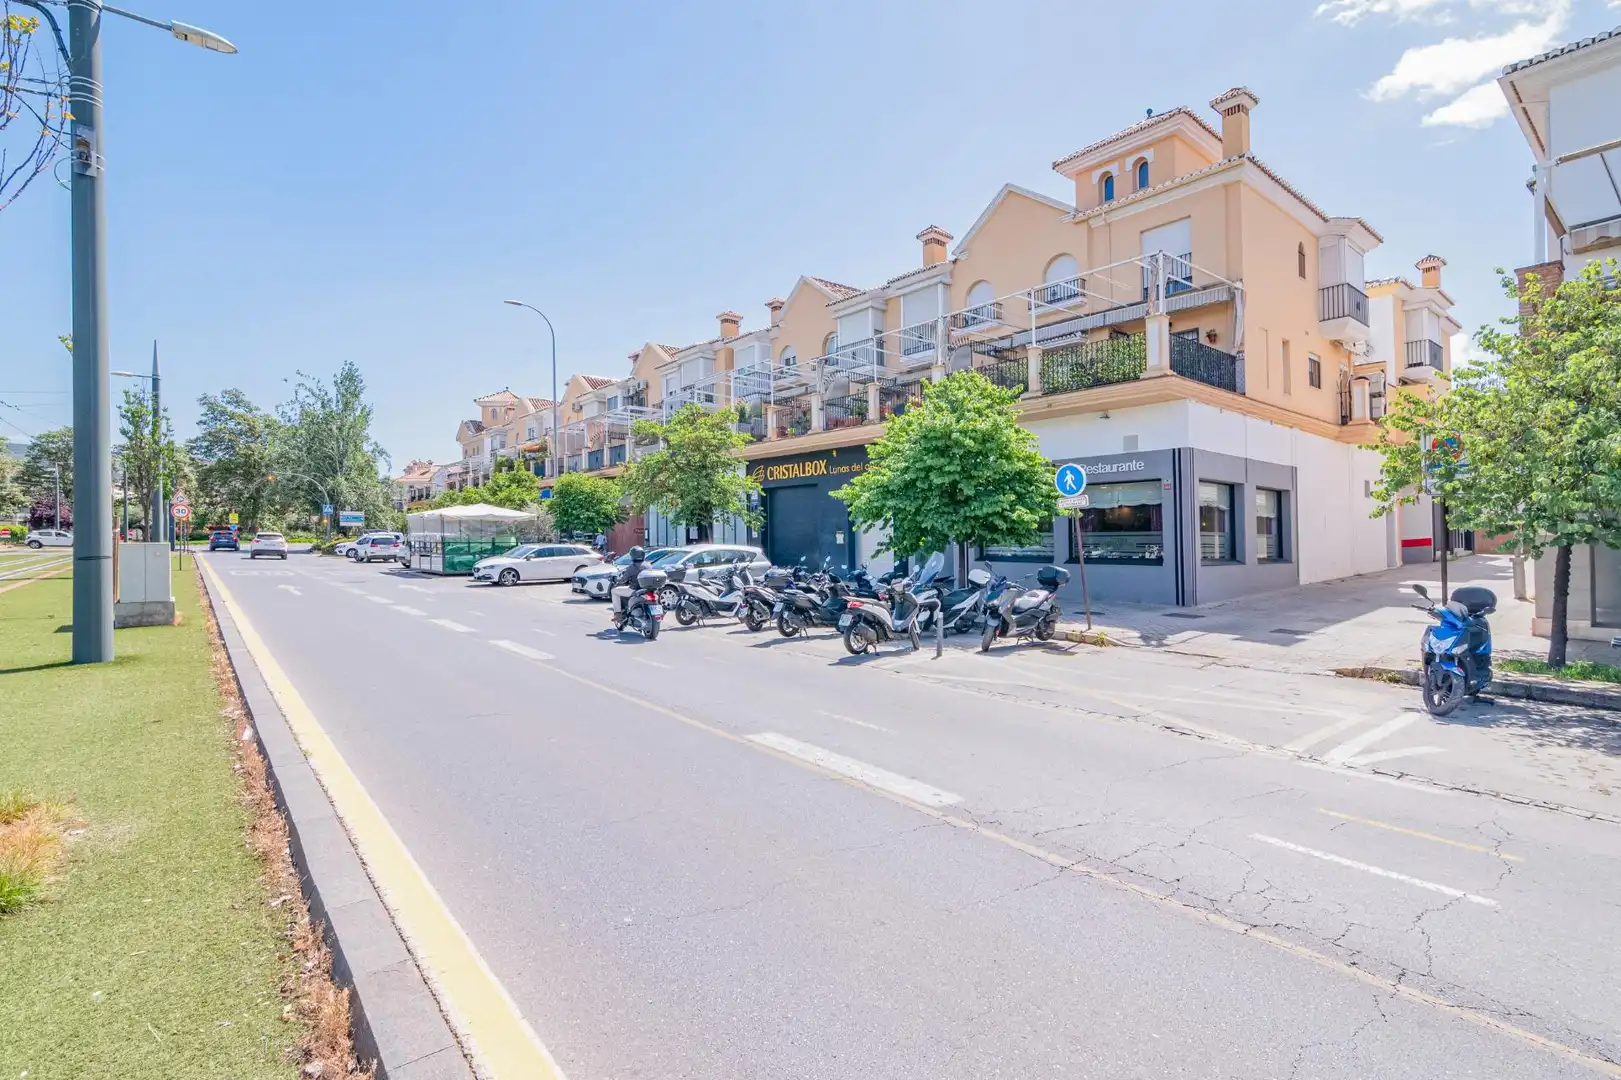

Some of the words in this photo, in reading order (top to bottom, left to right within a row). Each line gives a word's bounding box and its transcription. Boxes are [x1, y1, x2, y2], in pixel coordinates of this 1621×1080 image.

[767, 459, 827, 480] CRISTALBOX
[829, 465, 850, 474] Lunas
[852, 462, 863, 472] del
